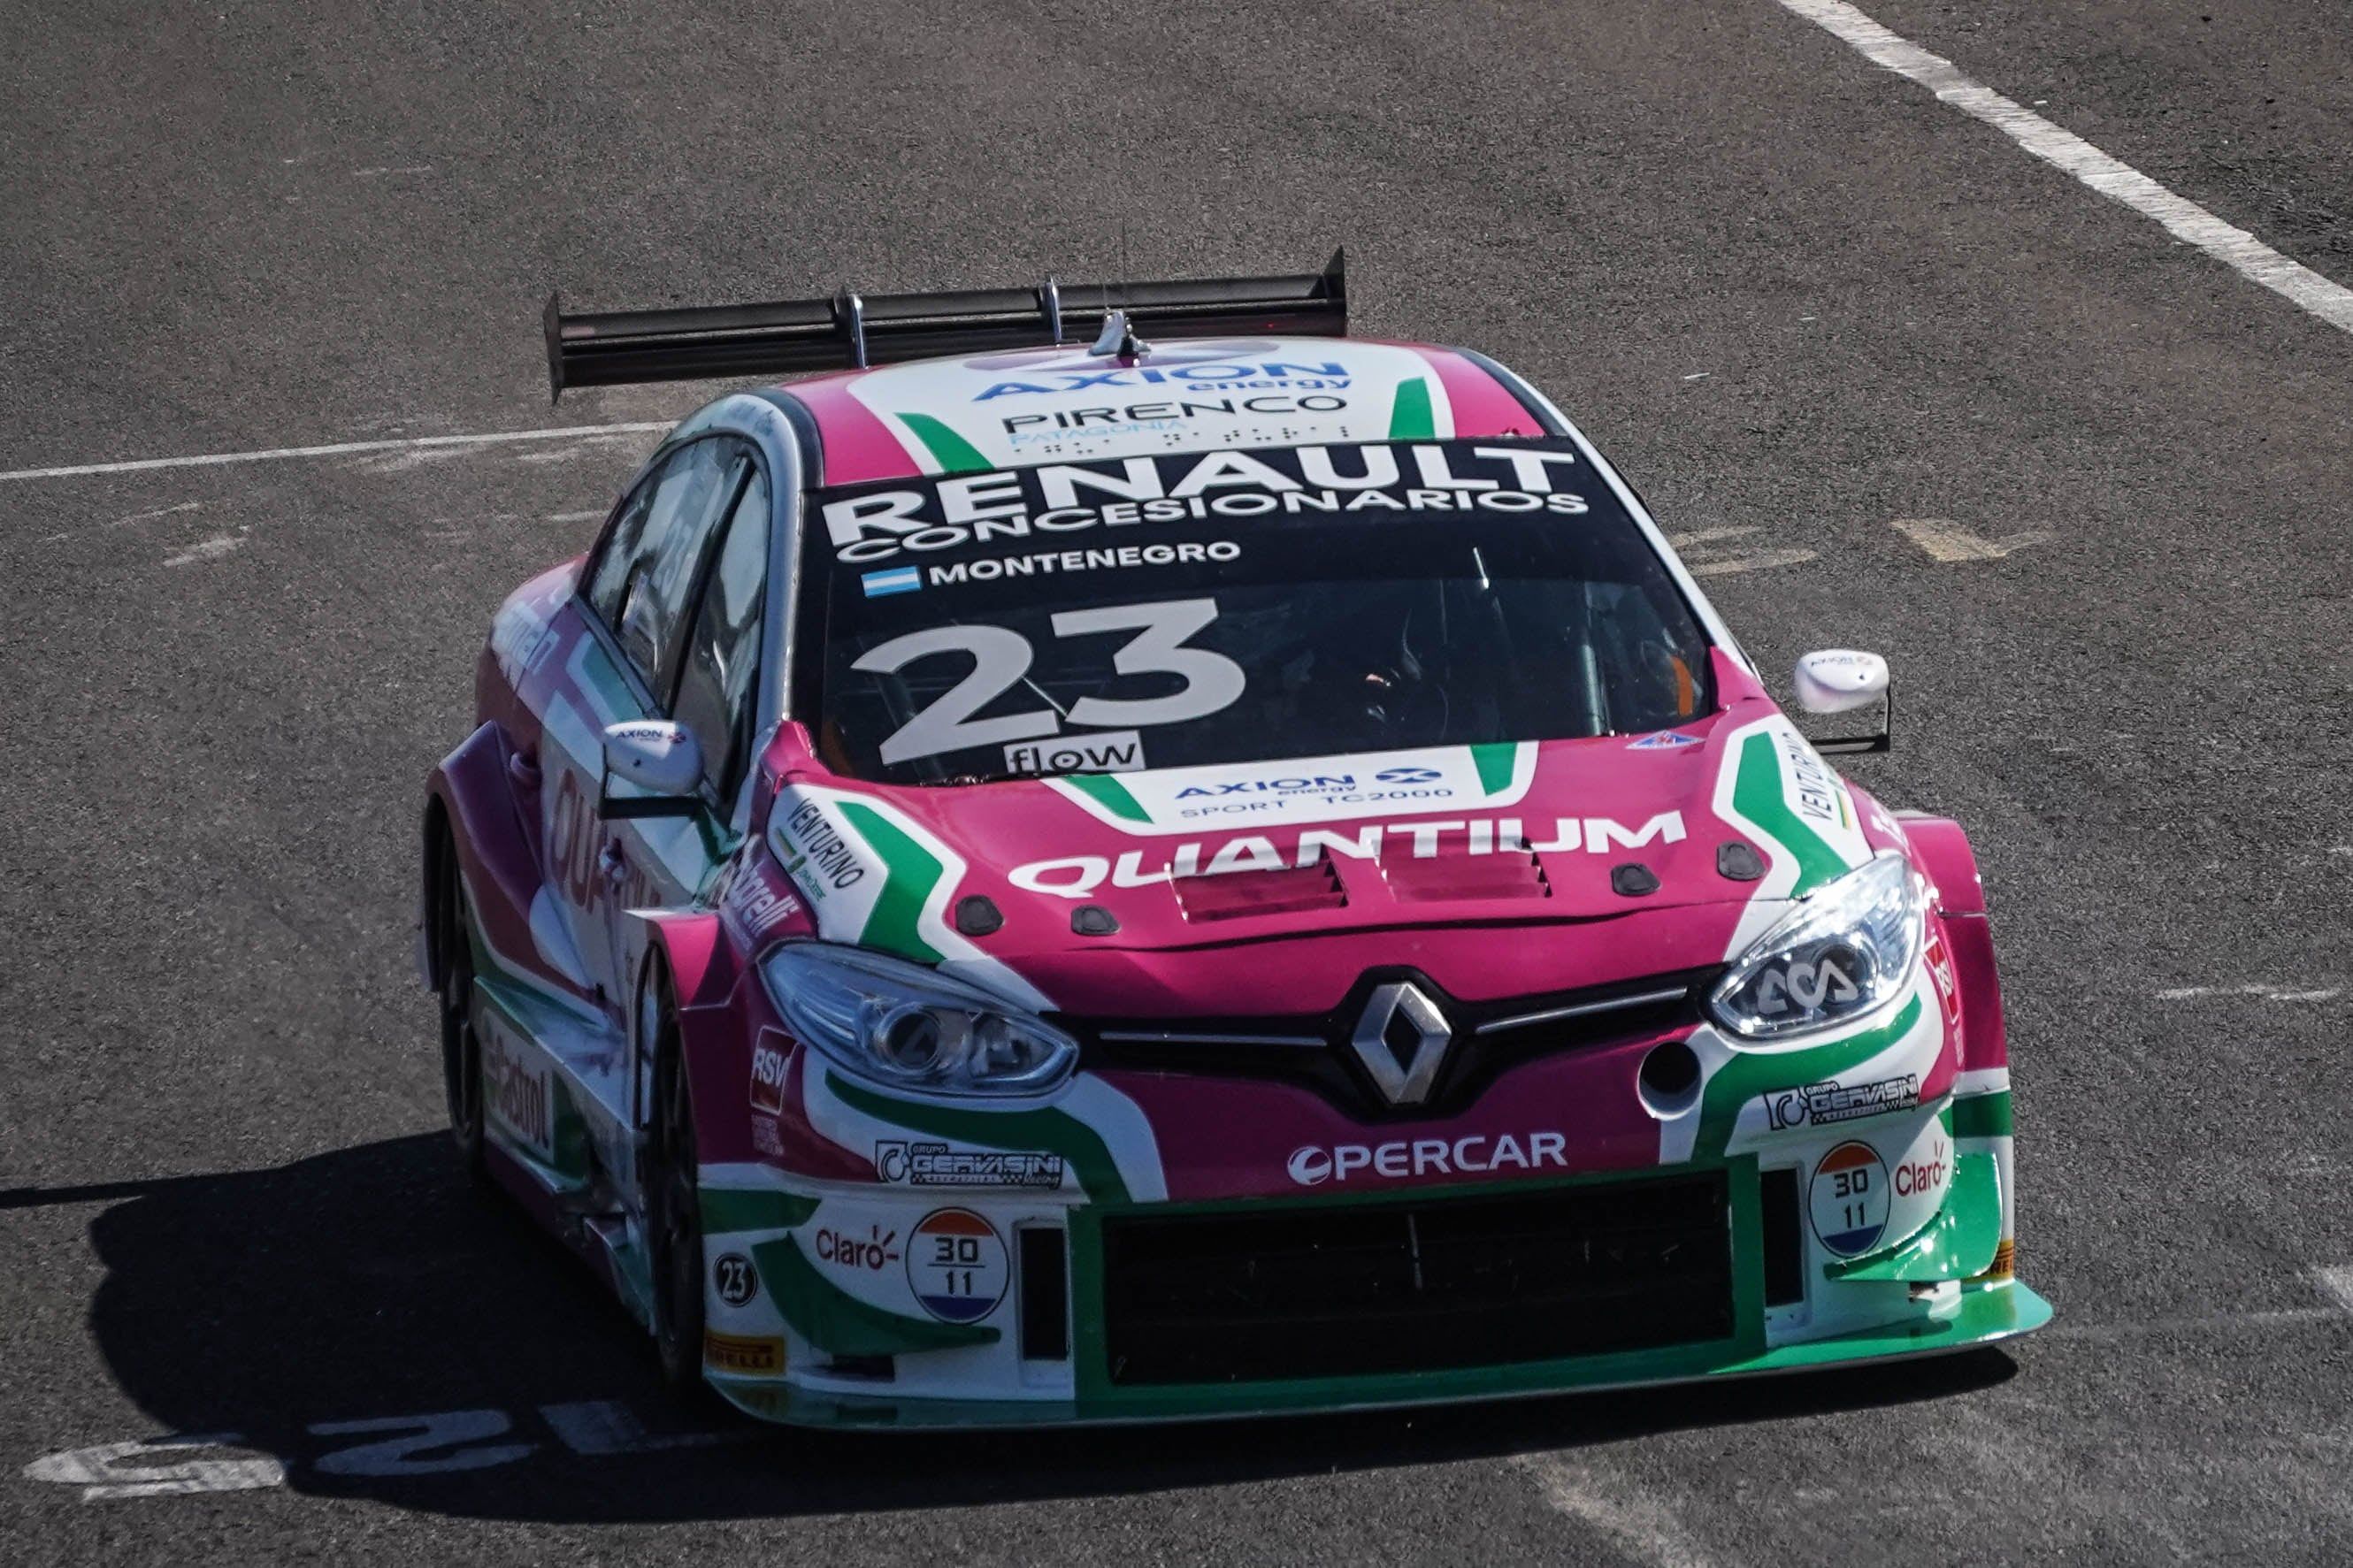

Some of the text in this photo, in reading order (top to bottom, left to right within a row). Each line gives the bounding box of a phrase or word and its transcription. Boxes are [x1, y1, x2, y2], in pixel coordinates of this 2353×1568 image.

[972, 362, 1349, 402] AXION
[1186, 378, 1353, 392] energy
[1000, 394, 1347, 434] PIRENCO
[1008, 419, 1188, 445] PATAGONIA
[821, 443, 1575, 547] RENAULT
[836, 488, 1590, 563] CONCESIONARIOS
[929, 540, 1241, 586] MONTENEGRO
[850, 598, 1246, 766] 23
[616, 729, 663, 739] AXION
[1008, 743, 1137, 775] flow
[1175, 775, 1356, 799] AXION
[1181, 788, 1452, 819] SPORT TC2000
[1276, 784, 1357, 797] energy
[787, 797, 866, 890] VENTURINO
[1008, 811, 1687, 898] QUANTIUM
[1334, 1132, 1568, 1181] PERCAR
[1834, 1169, 1869, 1198] 30
[1895, 1161, 1942, 1197] Claro
[1843, 1205, 1866, 1229] 11
[816, 1228, 883, 1270] Claro
[935, 1238, 979, 1264] 30
[721, 1258, 747, 1299] 23
[945, 1270, 972, 1295] 11
